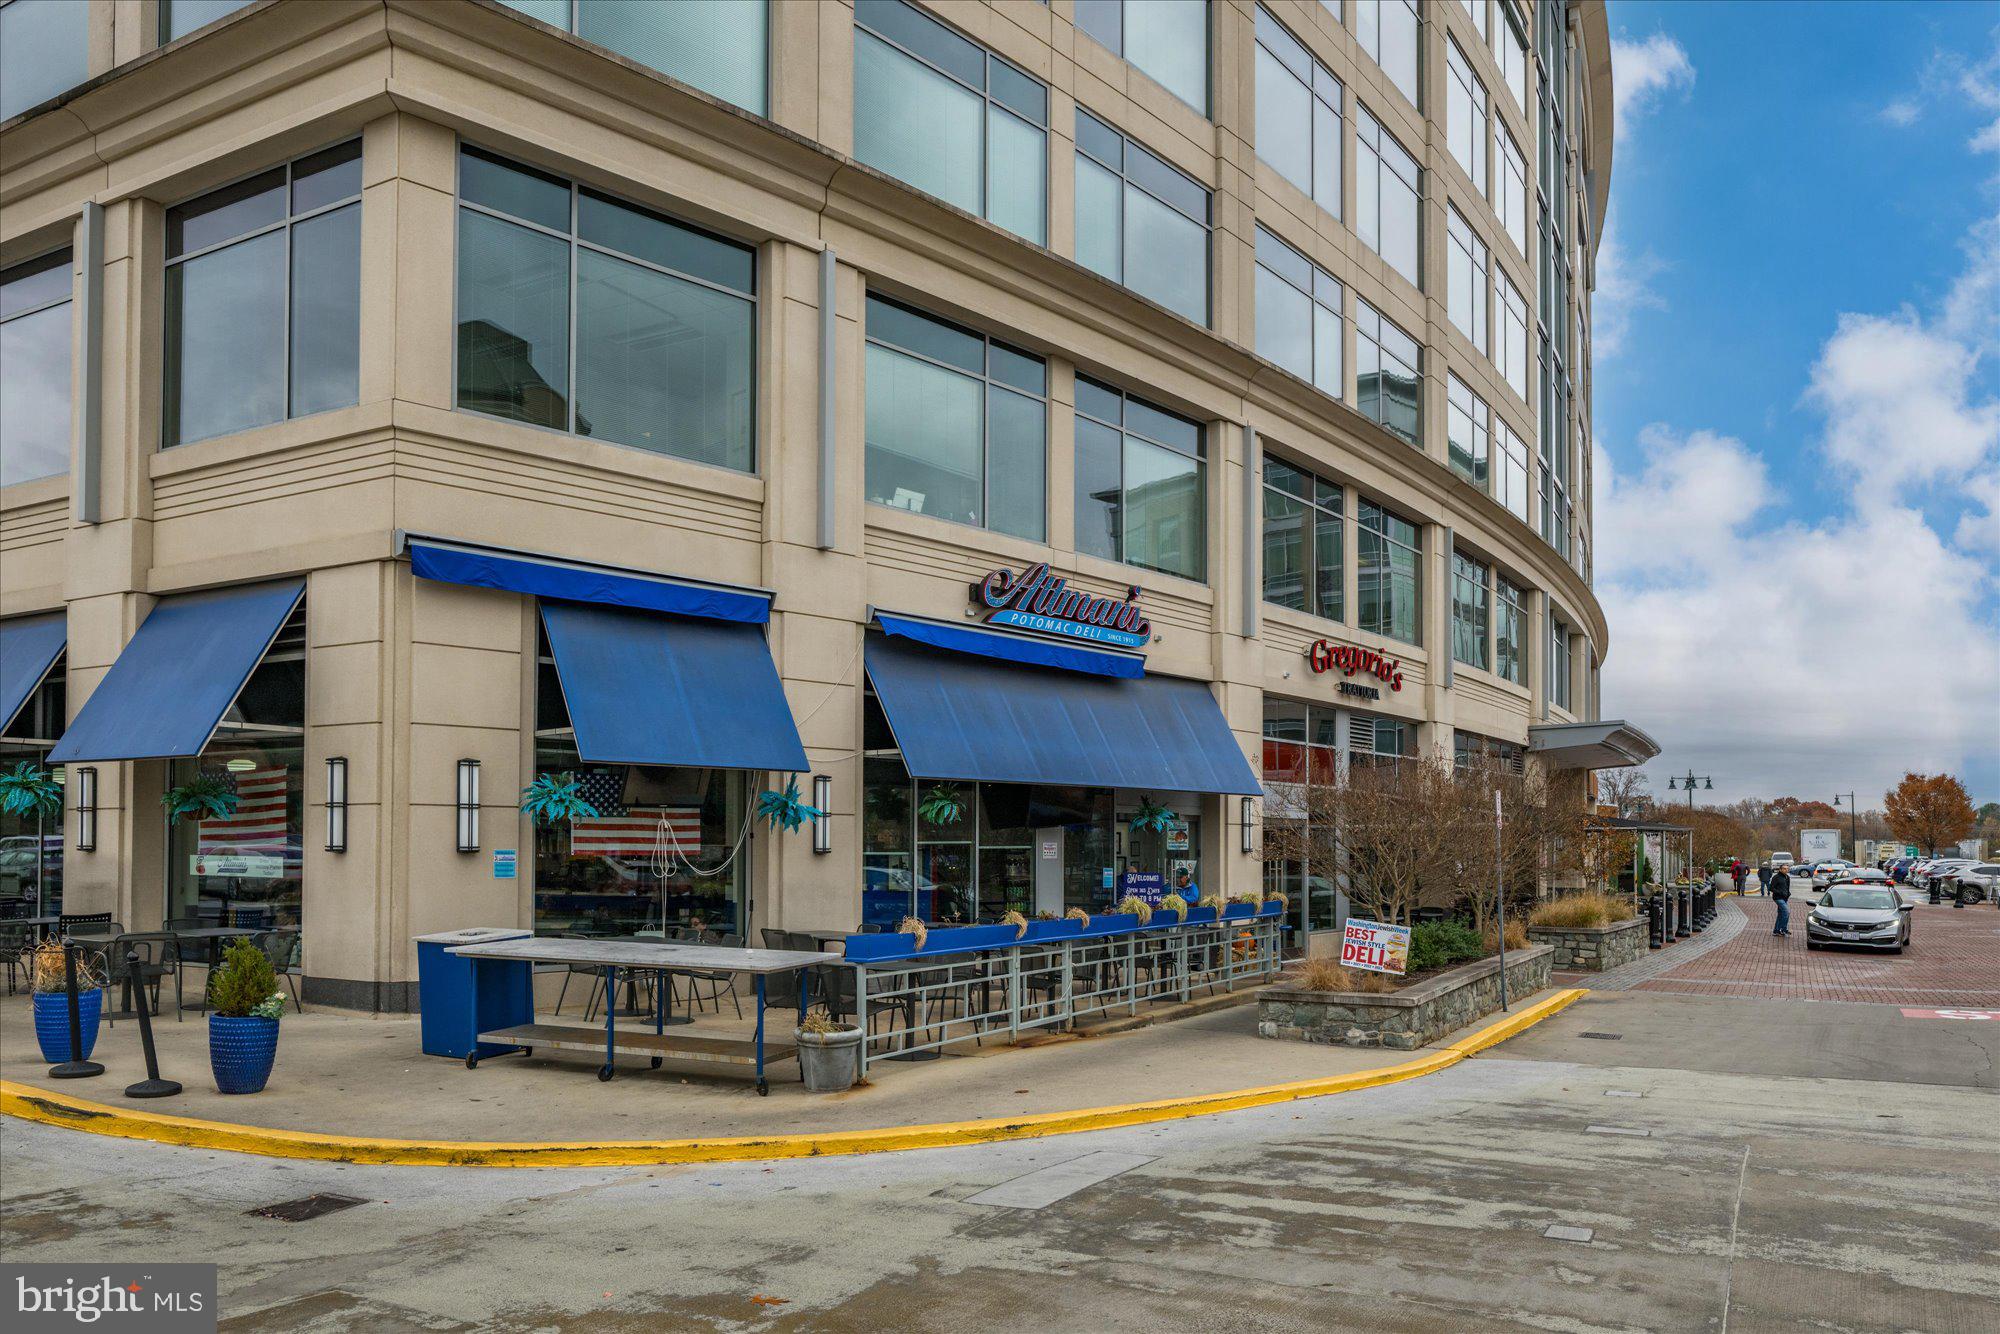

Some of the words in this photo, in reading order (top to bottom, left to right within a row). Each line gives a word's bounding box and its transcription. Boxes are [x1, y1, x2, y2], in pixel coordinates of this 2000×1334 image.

[1011, 613, 1069, 633] POTOMAC
[1074, 625, 1101, 639] DELI
[1107, 633, 1121, 643] SINCE
[1310, 639, 1403, 692] Gregorio's
[1340, 682, 1380, 700] TRATTORIA
[1346, 927, 1377, 941] BEST
[1346, 938, 1366, 946] JEWISH
[1367, 942, 1386, 950] STYLE
[1343, 944, 1385, 966] DELI
